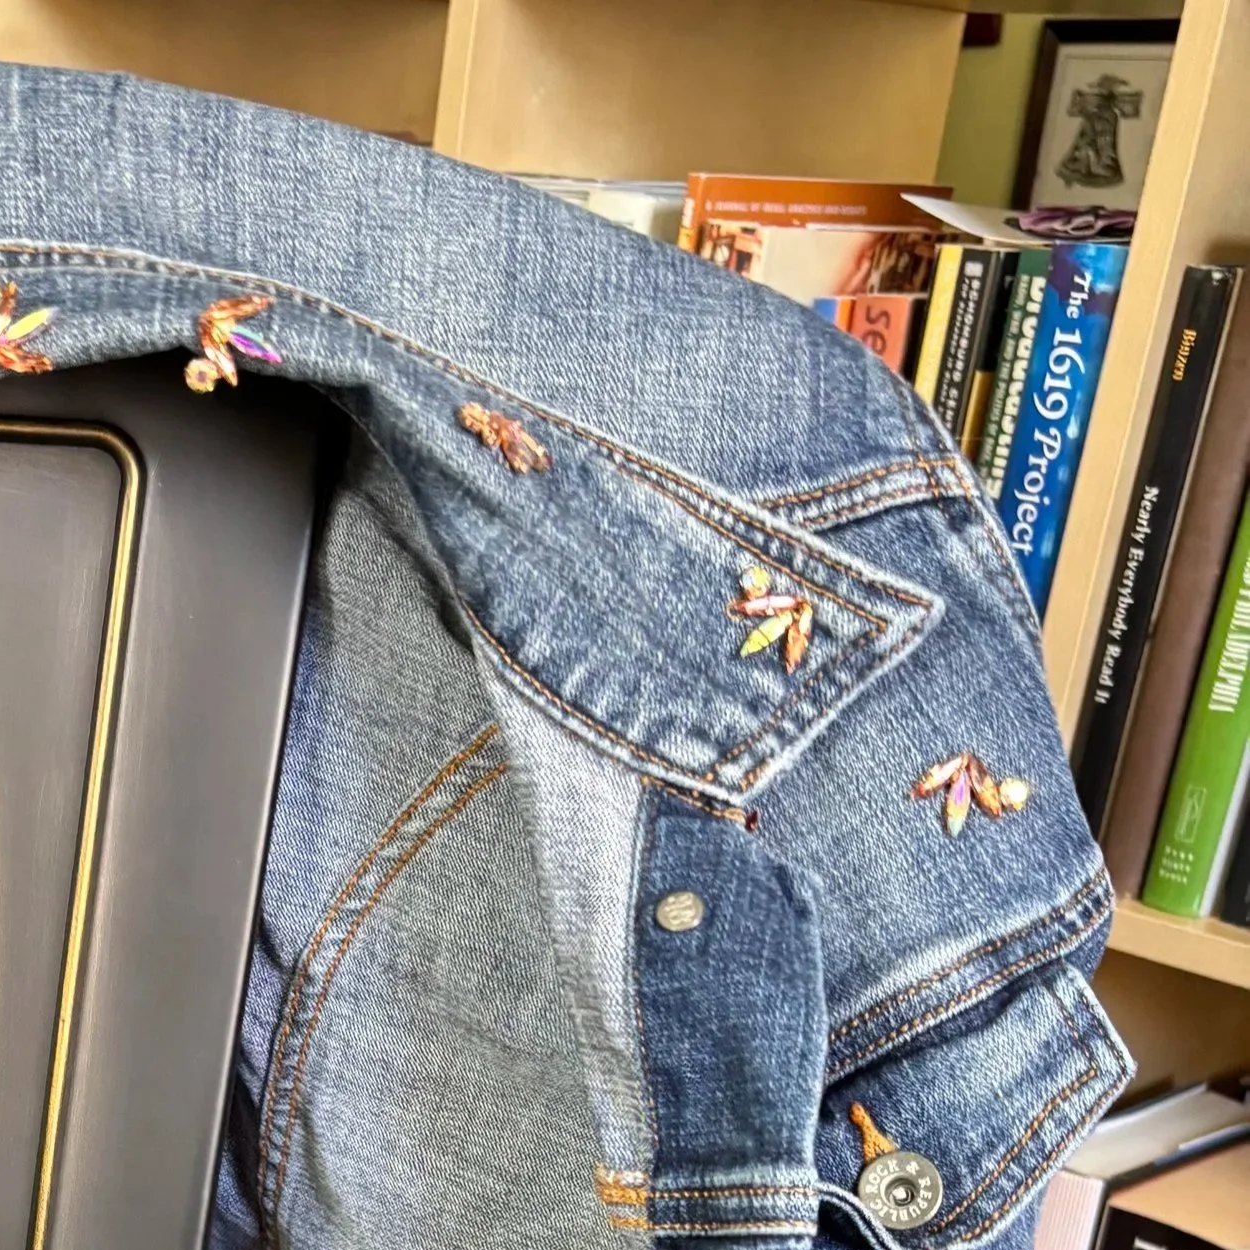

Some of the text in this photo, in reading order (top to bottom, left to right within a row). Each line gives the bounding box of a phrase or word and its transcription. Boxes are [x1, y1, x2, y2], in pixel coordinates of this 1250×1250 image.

[1010, 271, 1092, 556] The 1619 Project
[1094, 485, 1160, 704] Nearly Everybody Read It
[865, 1159, 899, 1193] ROCK
[870, 1176, 932, 1222] REPUBLIC
